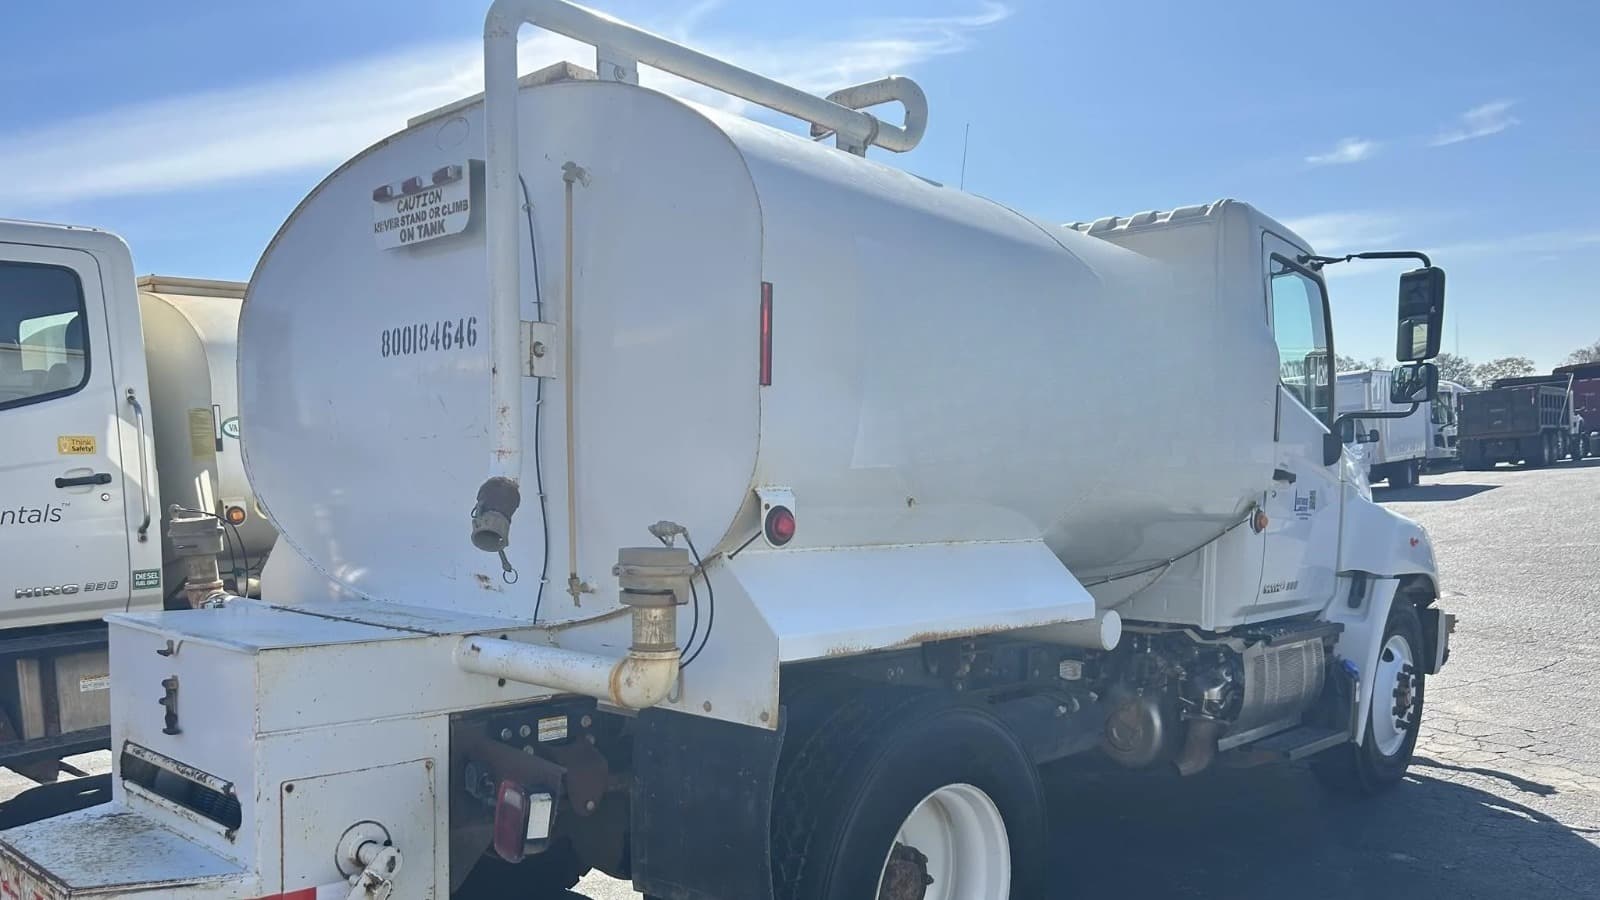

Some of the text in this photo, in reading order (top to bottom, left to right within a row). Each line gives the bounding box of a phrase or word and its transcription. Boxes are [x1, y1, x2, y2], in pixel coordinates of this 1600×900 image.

[397, 188, 443, 214] CAUTION
[374, 199, 469, 234] NEVER STAND OR CLIMB
[400, 219, 446, 243] ON TANK
[381, 316, 478, 358] 800184646
[71, 438, 92, 446] Think
[71, 445, 94, 453] Safety!
[135, 572, 159, 581] DIESEL
[15, 583, 79, 599] HINO
